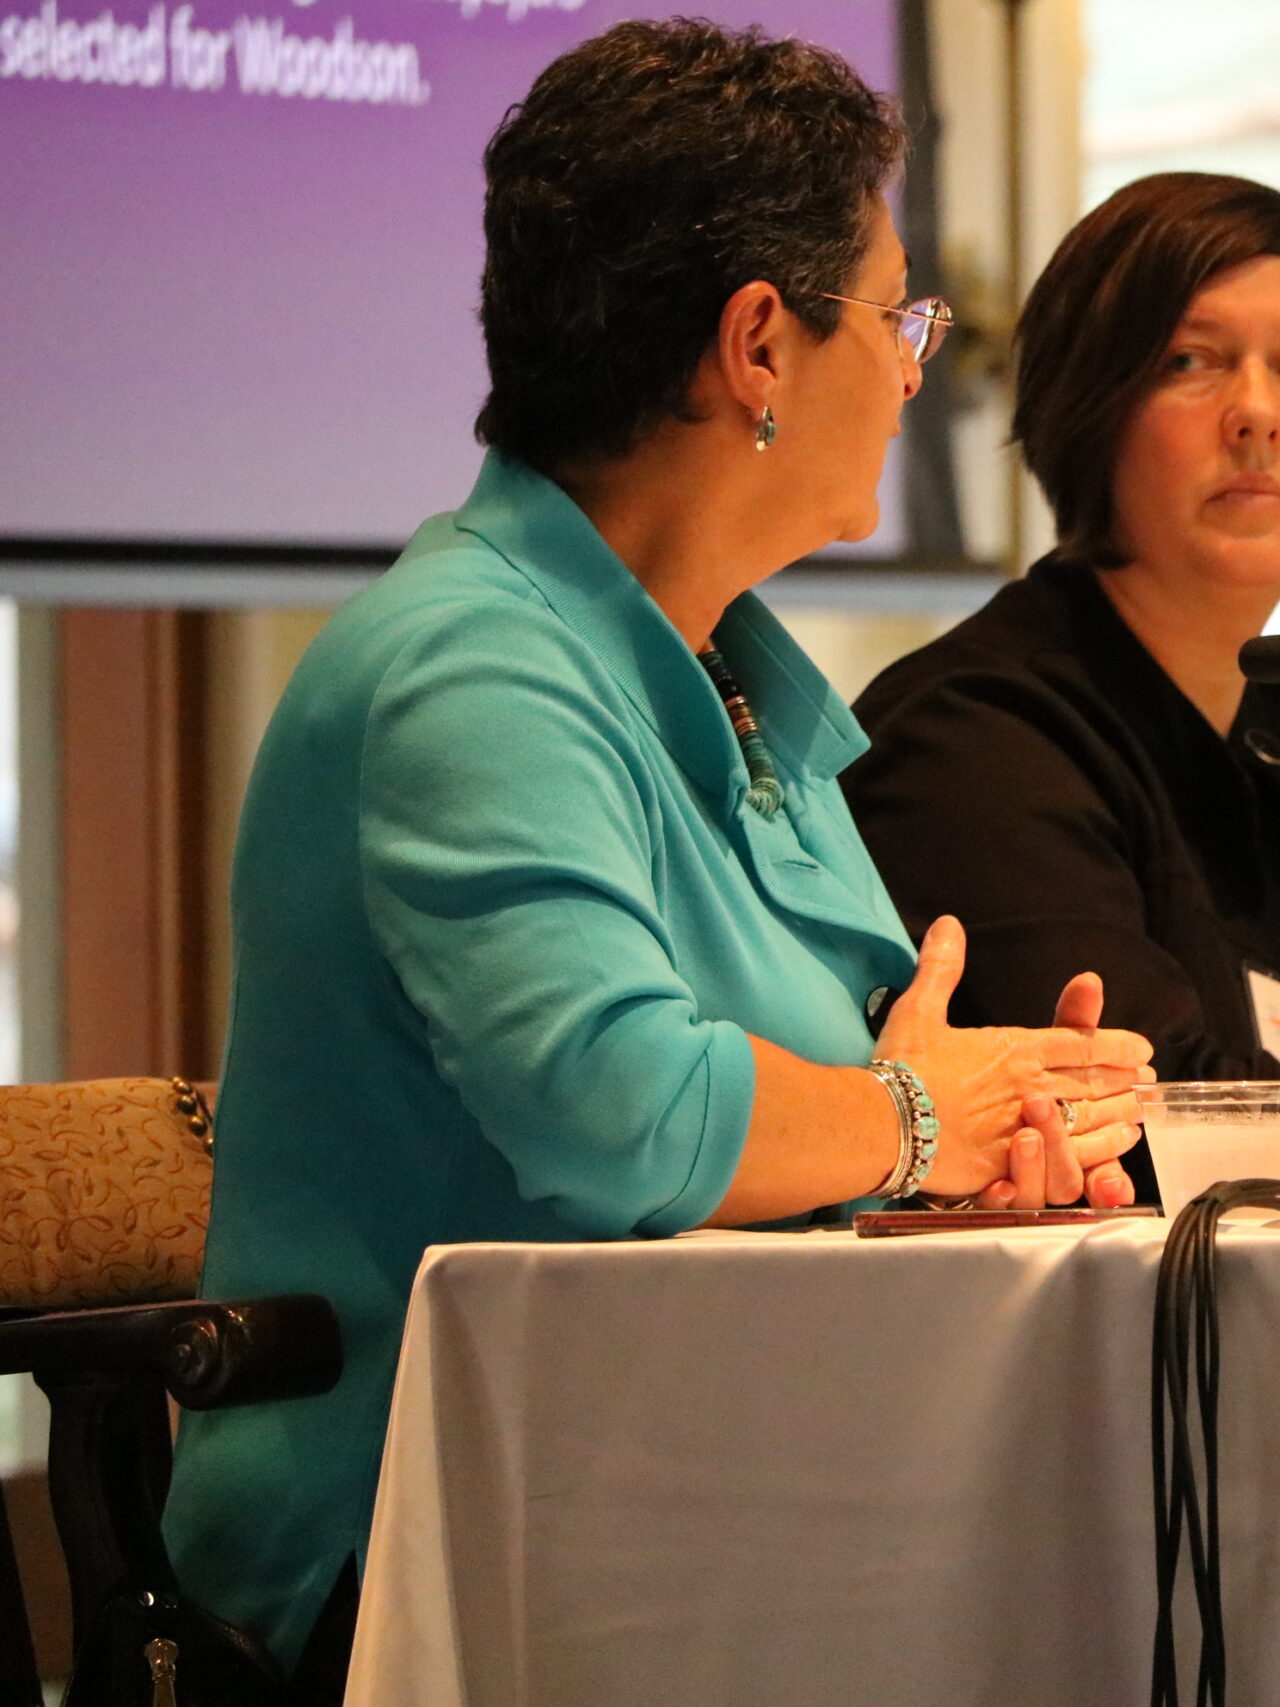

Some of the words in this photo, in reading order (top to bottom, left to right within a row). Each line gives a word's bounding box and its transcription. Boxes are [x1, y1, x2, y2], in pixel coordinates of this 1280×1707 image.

[0, 0, 166, 87] selected
[171, 3, 230, 91] for
[234, 15, 430, 106] Woodson.
